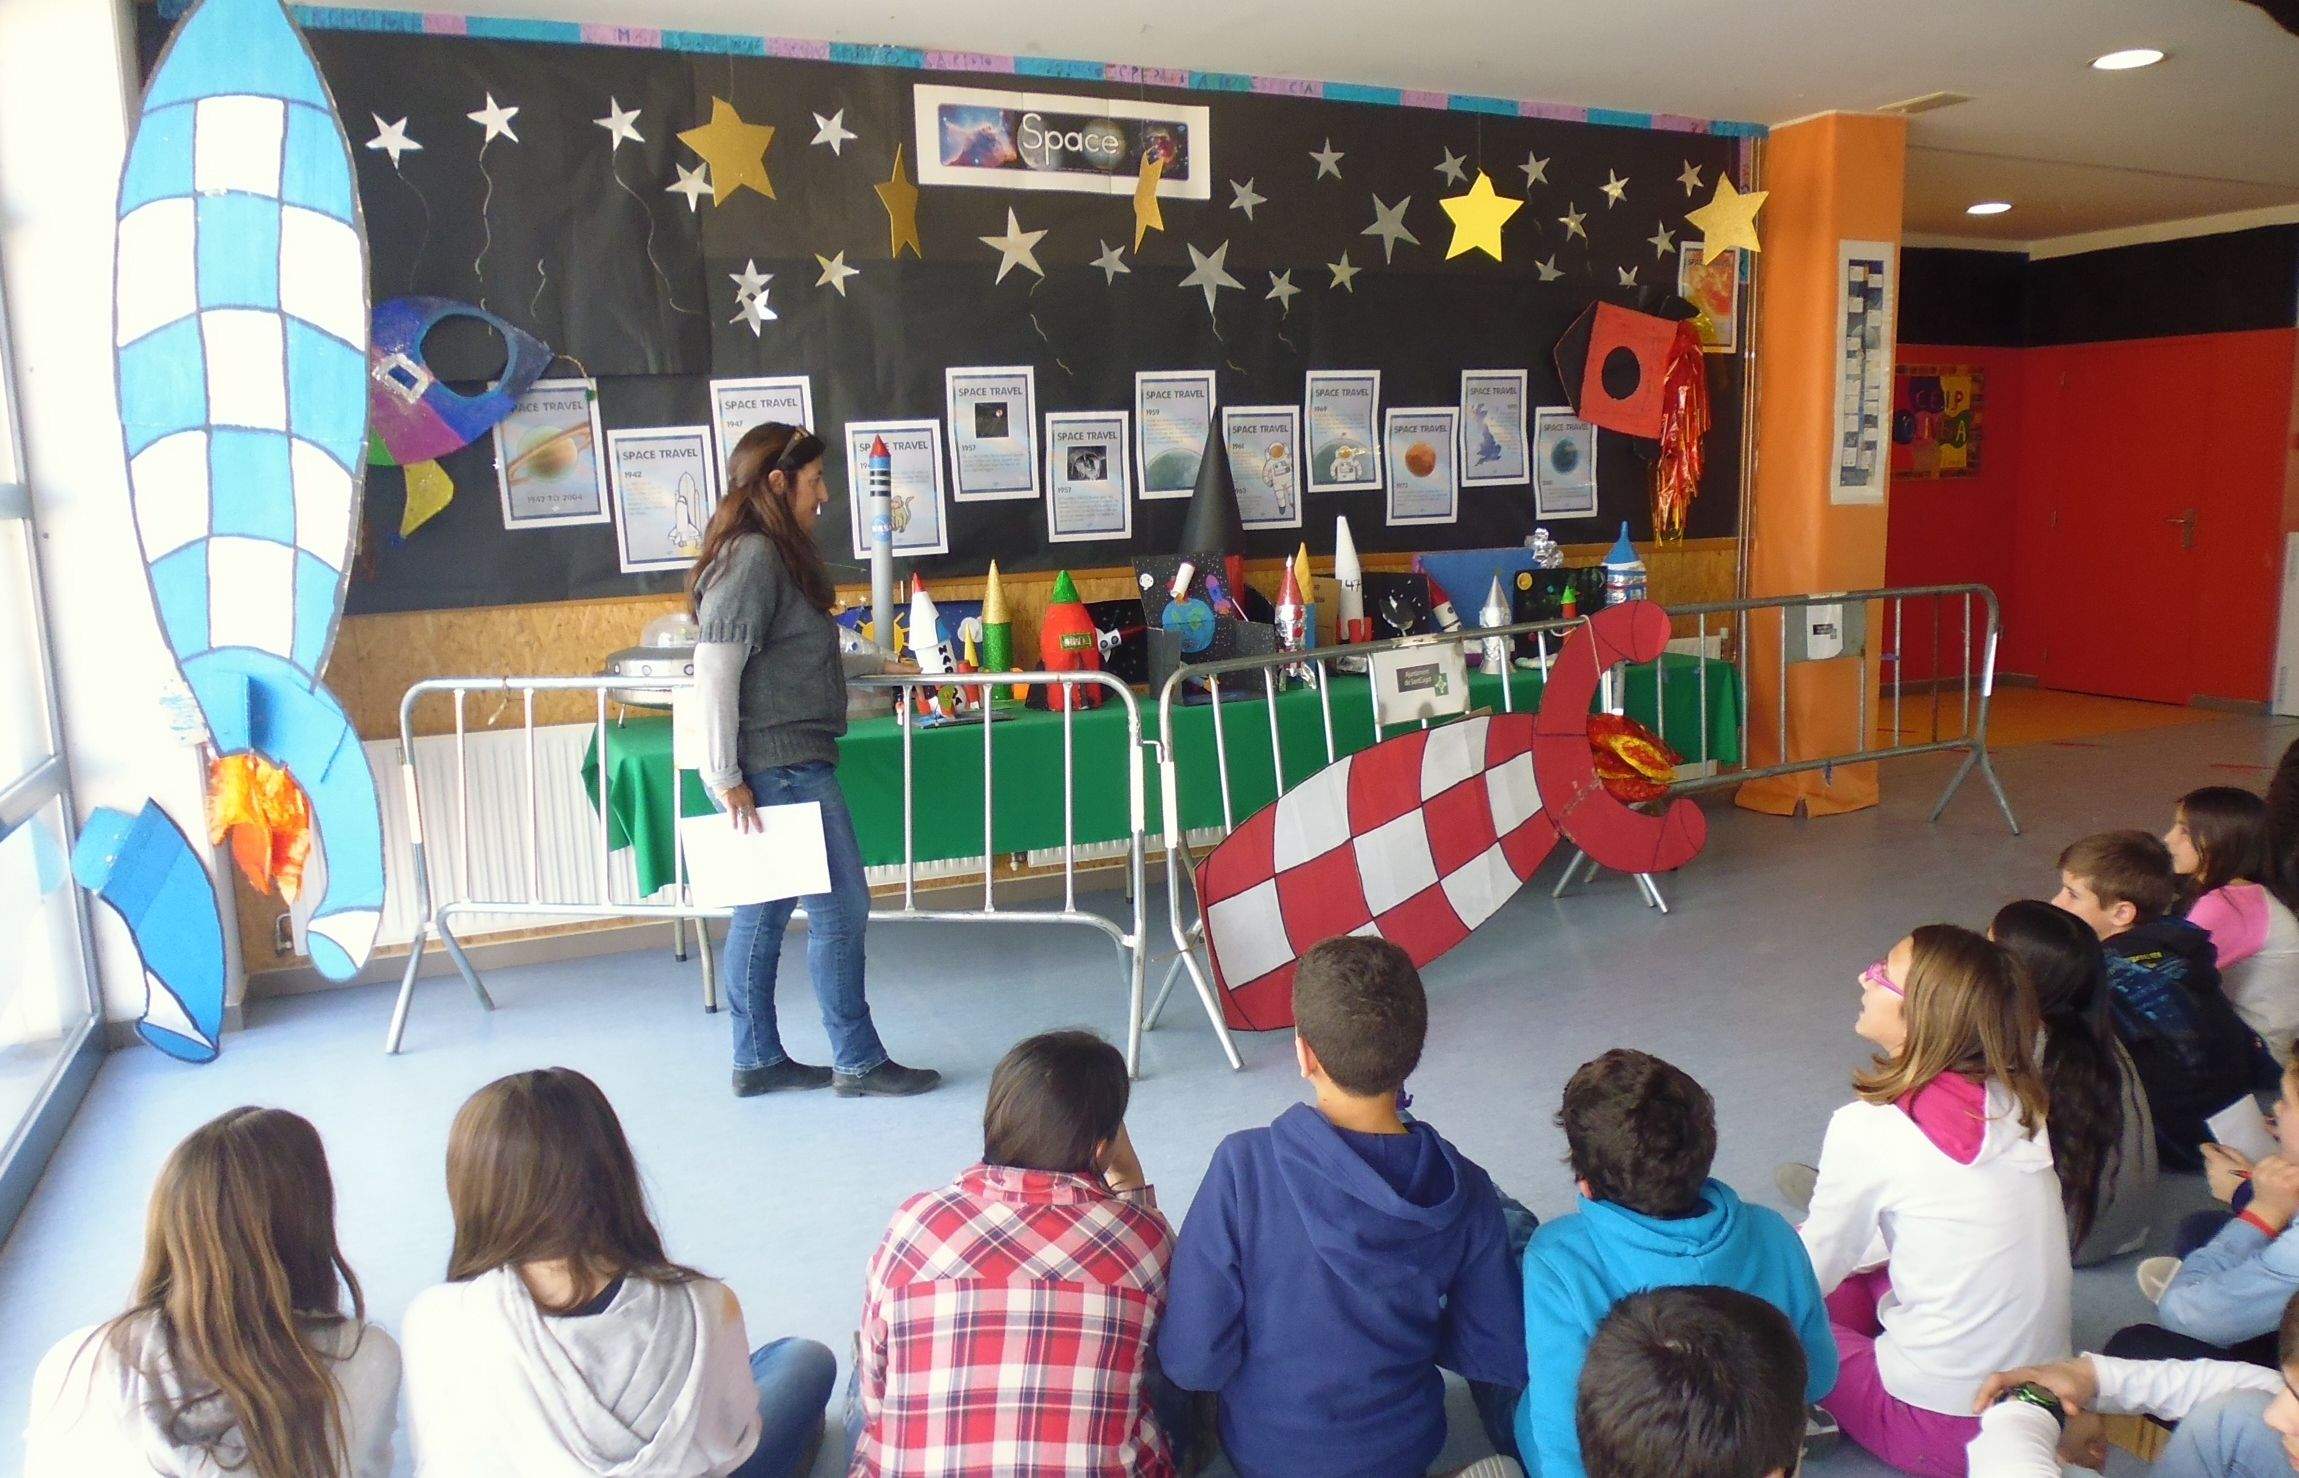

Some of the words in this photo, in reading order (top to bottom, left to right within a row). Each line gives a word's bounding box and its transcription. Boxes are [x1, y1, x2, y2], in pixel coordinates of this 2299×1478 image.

[1022, 113, 1119, 166] Space
[959, 387, 987, 397] SPACE
[990, 386, 1023, 396] TRAVEL
[1146, 390, 1172, 400] SPACE
[1174, 389, 1205, 399] TRAVEL
[1315, 388, 1340, 397] SPACE
[1341, 388, 1369, 397] TRAVEL
[1470, 387, 1490, 396] SPACE
[1492, 387, 1517, 395] TRAVEL
[542, 400, 584, 412] TRAVEL
[724, 400, 758, 410] SPACE
[760, 398, 798, 408] TRAVEL
[726, 420, 744, 428] 1947
[1232, 425, 1258, 434] SPACE
[1260, 424, 1289, 433] TRAVEL
[1394, 425, 1418, 434] SPACE
[1420, 424, 1448, 433] TRAVEL
[1543, 423, 1564, 432] SPACE
[1057, 431, 1085, 441] SPACE
[1086, 430, 1118, 440] TRAVEL
[893, 440, 929, 451] TRAVEL
[961, 444, 976, 452] 1957
[622, 449, 656, 461] SPACE
[659, 447, 699, 459] TRAVEL
[624, 471, 642, 479] 1942
[1057, 486, 1072, 494] 1957
[1345, 579, 1361, 593] 47
